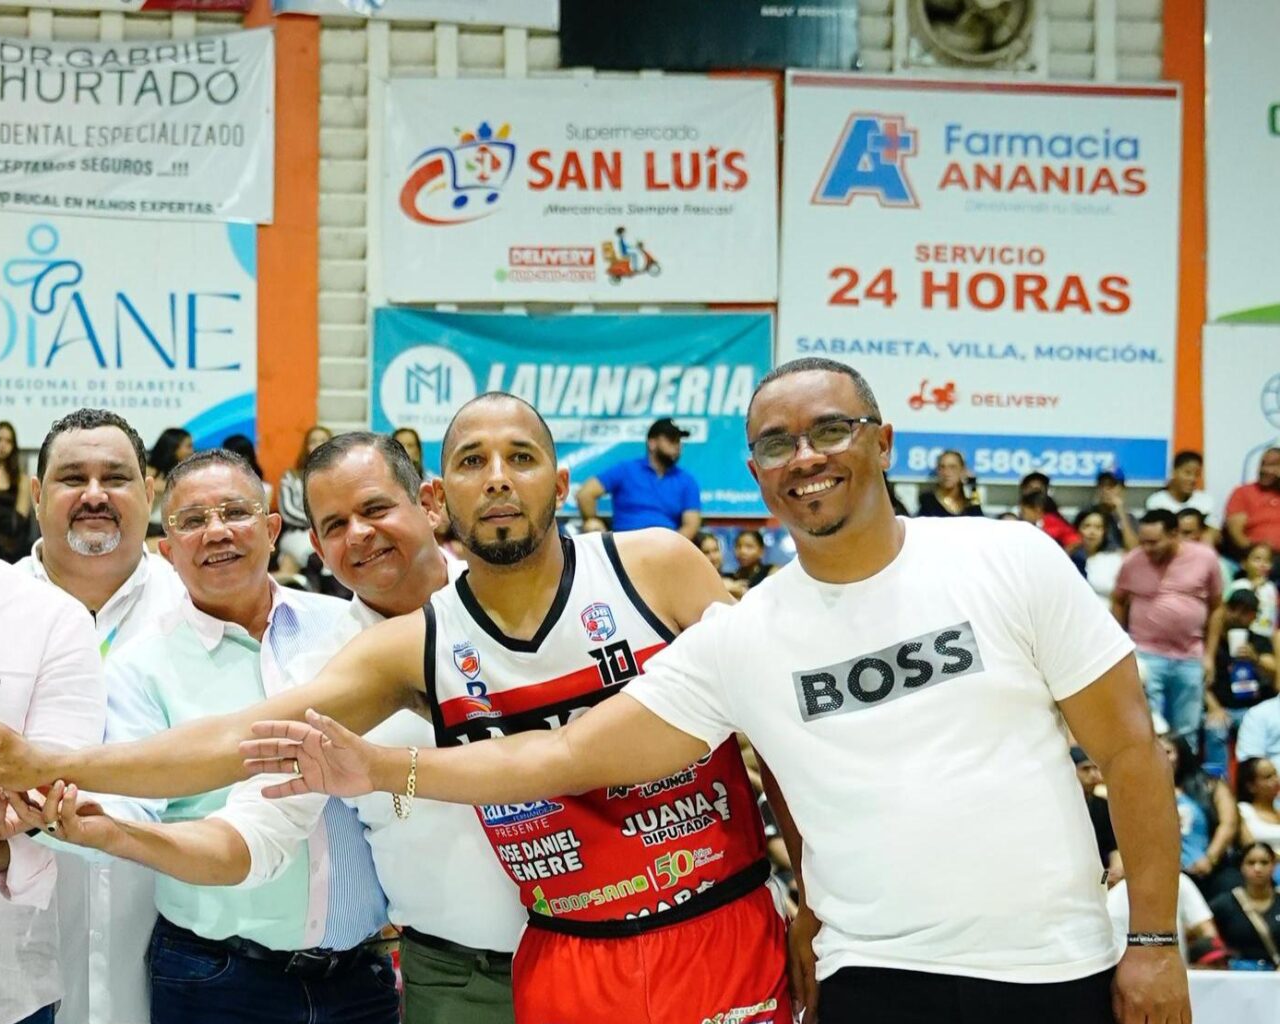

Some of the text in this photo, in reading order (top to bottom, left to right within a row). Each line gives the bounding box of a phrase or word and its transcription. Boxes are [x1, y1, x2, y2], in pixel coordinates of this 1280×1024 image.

[0, 69, 239, 106] HURTADO
[0, 122, 78, 147] DENTAL
[85, 121, 245, 148] ESPECIALIZADO
[566, 123, 699, 143] Supermercado
[944, 124, 1139, 161] Farmacia
[80, 158, 152, 176] SEGUROS
[527, 150, 620, 191] SAN
[938, 162, 1148, 196] ANANIAS
[64, 196, 83, 208] EN
[87, 197, 136, 213] MANOS
[511, 248, 593, 265] DELIVERY
[915, 244, 1046, 266] SERVICIO
[827, 267, 1132, 315] 24 HORAS
[796, 337, 1163, 364] SABANETA, VILLA, MONCIÓN.
[88, 379, 108, 391] DE
[485, 362, 754, 417] LAVANDERIA
[41, 397, 184, 409] ESPECIALIDADES
[971, 393, 1059, 409] DELIVERY
[908, 446, 1115, 476] 80 580-2837
[588, 640, 638, 686] 10
[801, 630, 973, 715] BOSS
[643, 771, 694, 797] LOUNGE
[495, 818, 549, 838] PRESENTE
[622, 792, 714, 836] JUANA
[521, 829, 581, 861] DANIEL
[642, 817, 715, 846] DIPUTADA
[509, 851, 583, 881] ENERE
[655, 850, 694, 889] 50
